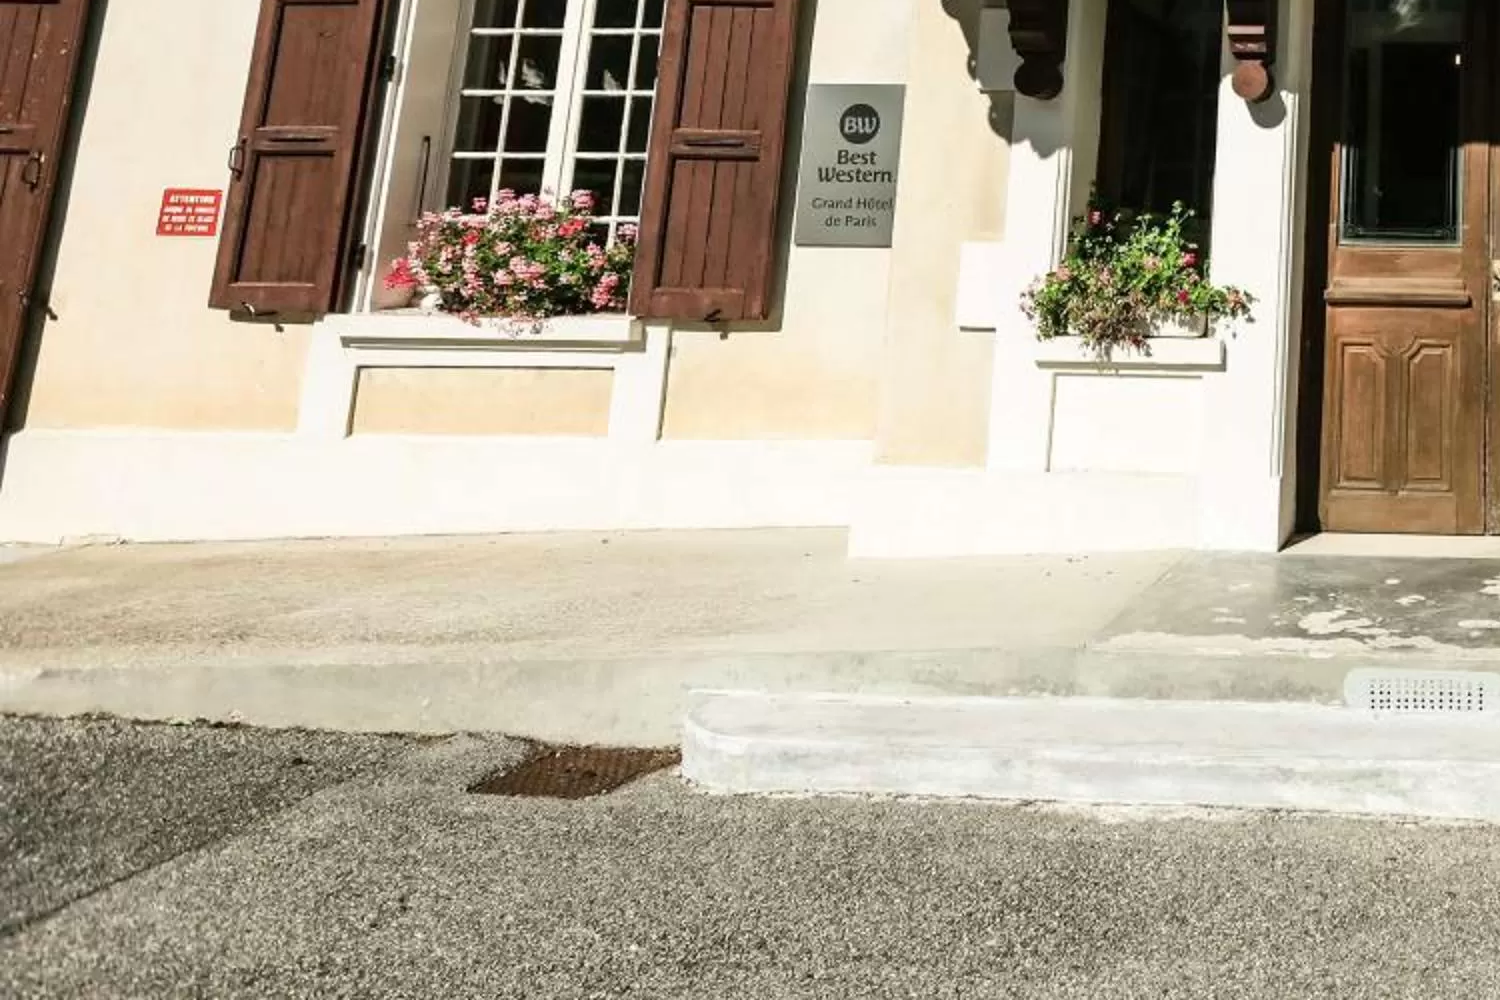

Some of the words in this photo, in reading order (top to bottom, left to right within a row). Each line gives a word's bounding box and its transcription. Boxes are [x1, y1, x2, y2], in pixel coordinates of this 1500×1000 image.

[844, 116, 877, 134] BW
[837, 149, 878, 165] Best
[811, 197, 853, 210] Grand
[856, 197, 894, 211] Hôtel
[825, 215, 841, 227] de
[845, 215, 877, 227] Paris
